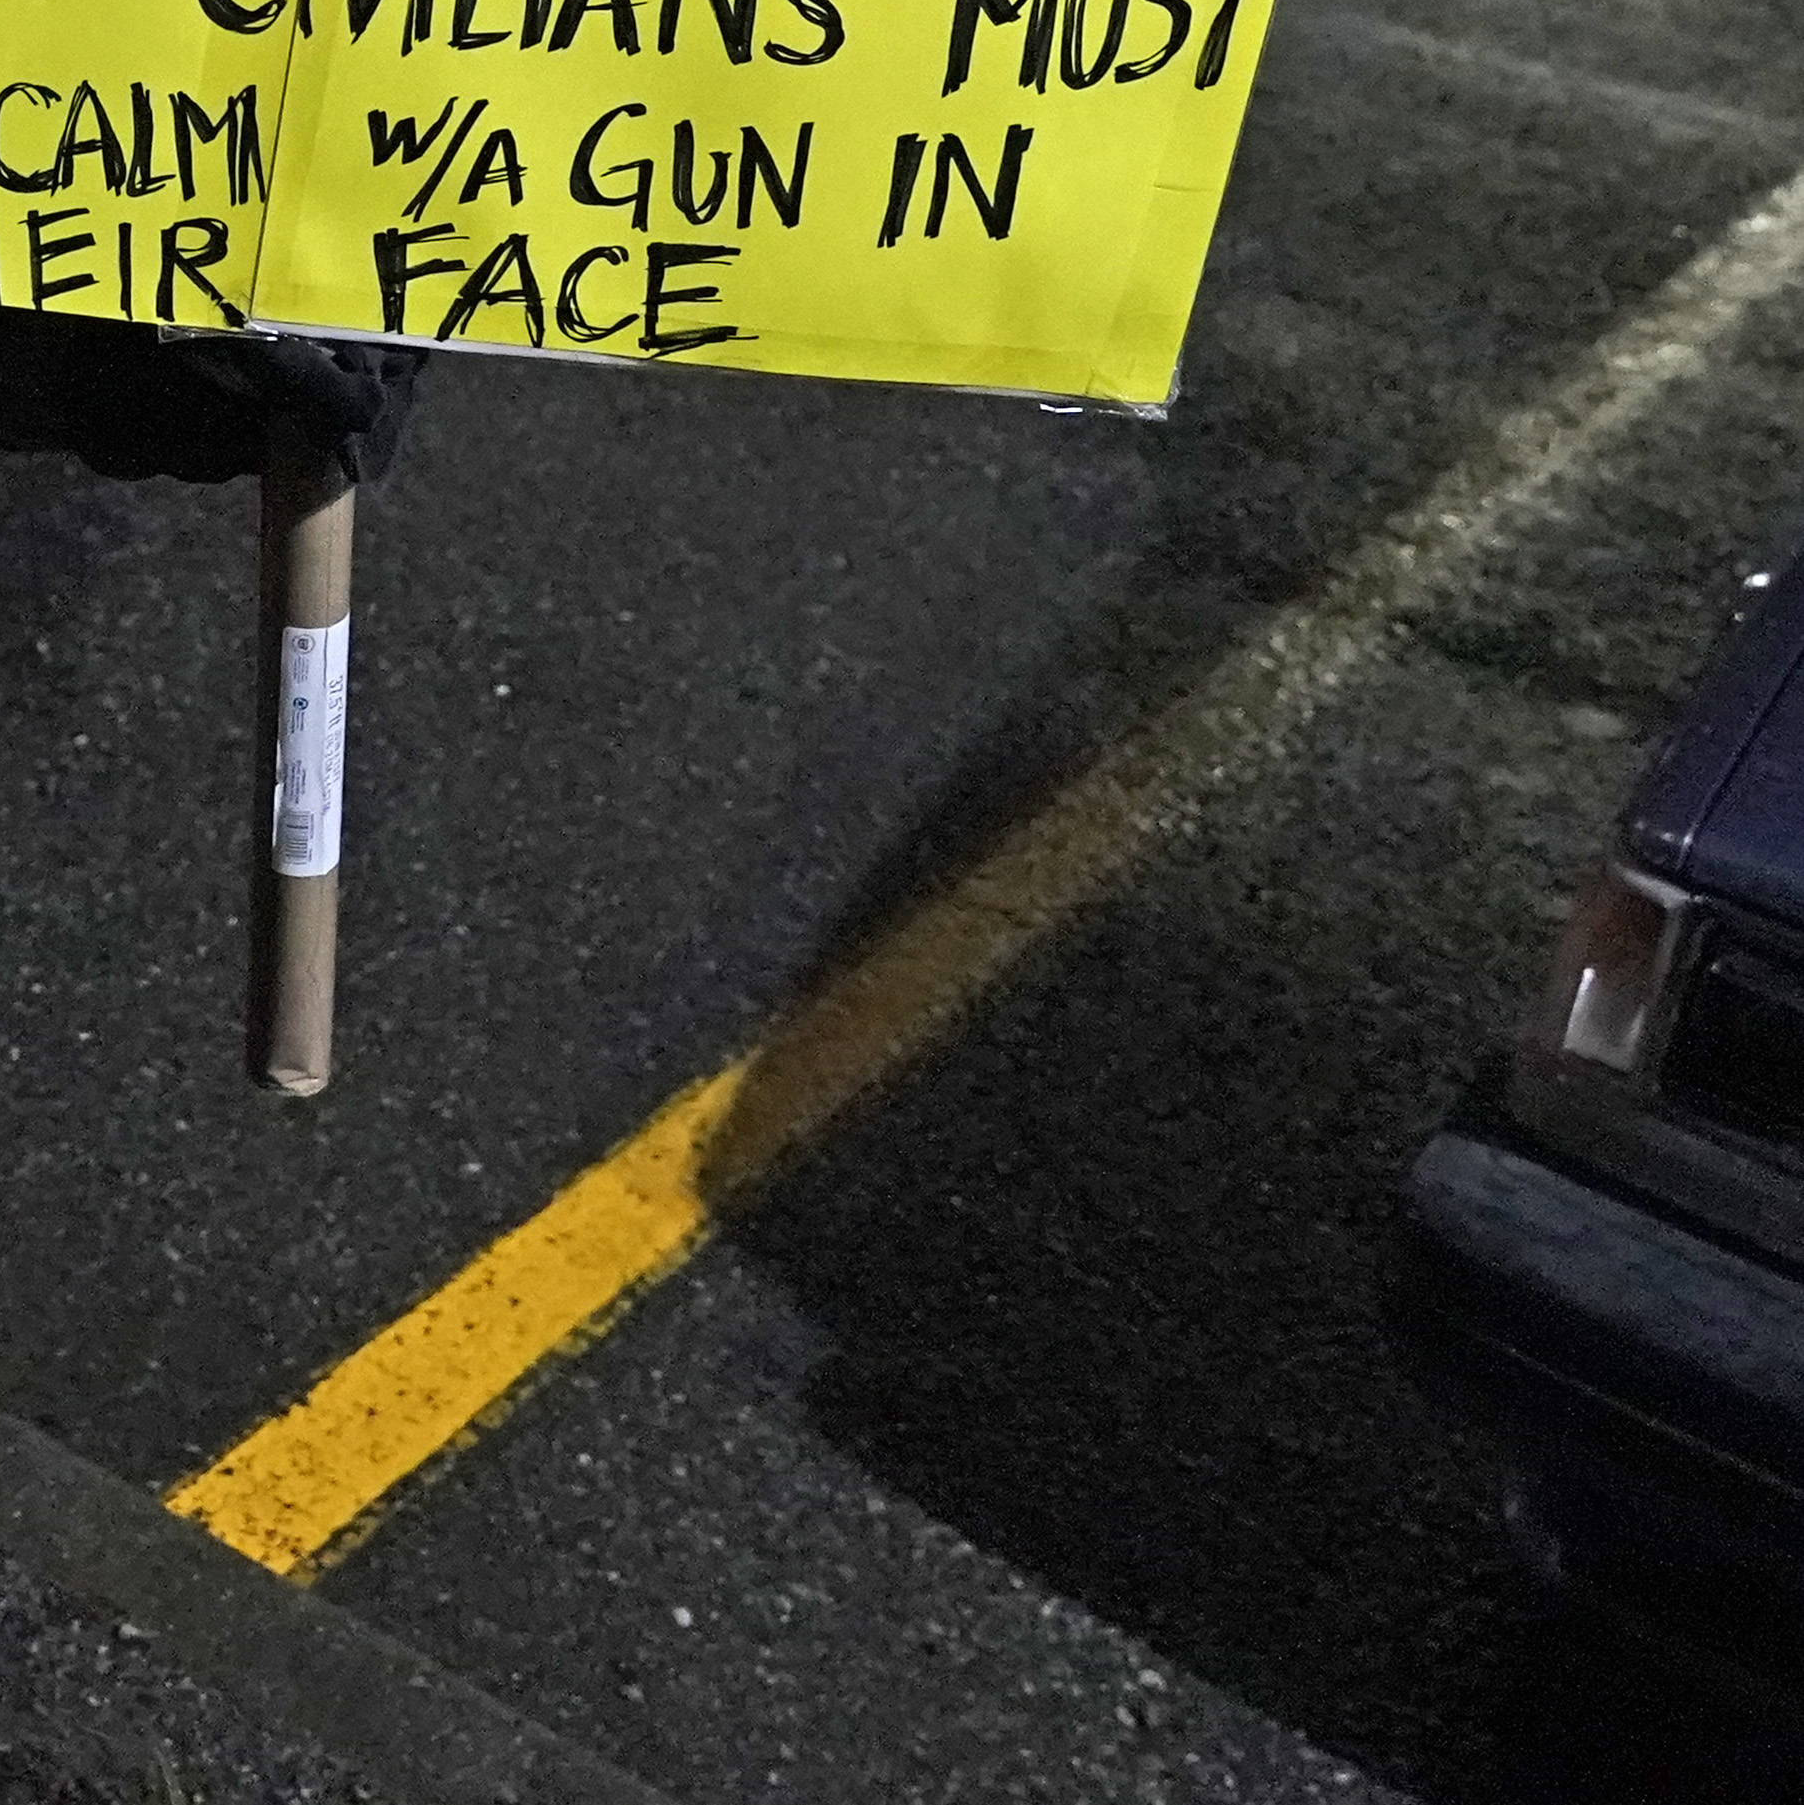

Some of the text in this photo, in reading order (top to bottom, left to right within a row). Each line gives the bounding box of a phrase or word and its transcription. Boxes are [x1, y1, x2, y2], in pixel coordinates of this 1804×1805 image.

[570, 103, 814, 232] GUN
[878, 124, 1034, 248] IN
[370, 219, 759, 354] FACE
